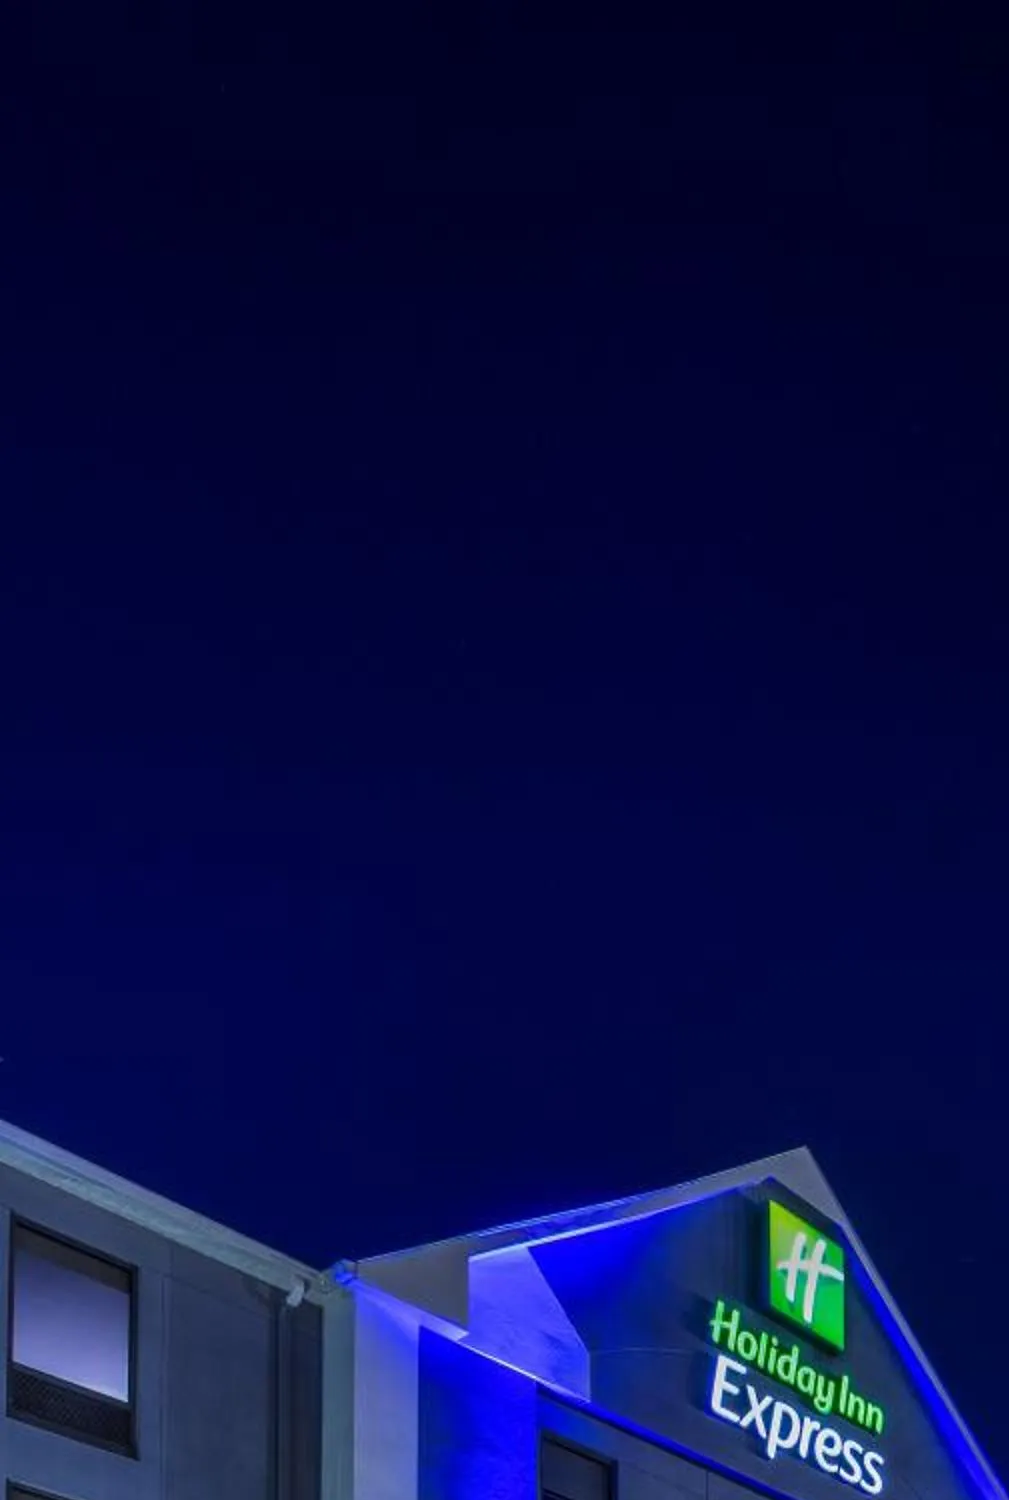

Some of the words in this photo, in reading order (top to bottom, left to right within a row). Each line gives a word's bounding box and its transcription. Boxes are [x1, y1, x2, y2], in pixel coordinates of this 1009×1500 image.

[777, 1232, 844, 1323] H
[709, 1300, 835, 1414] Holiday
[839, 1375, 883, 1434] Inn
[711, 1354, 884, 1494] Express
